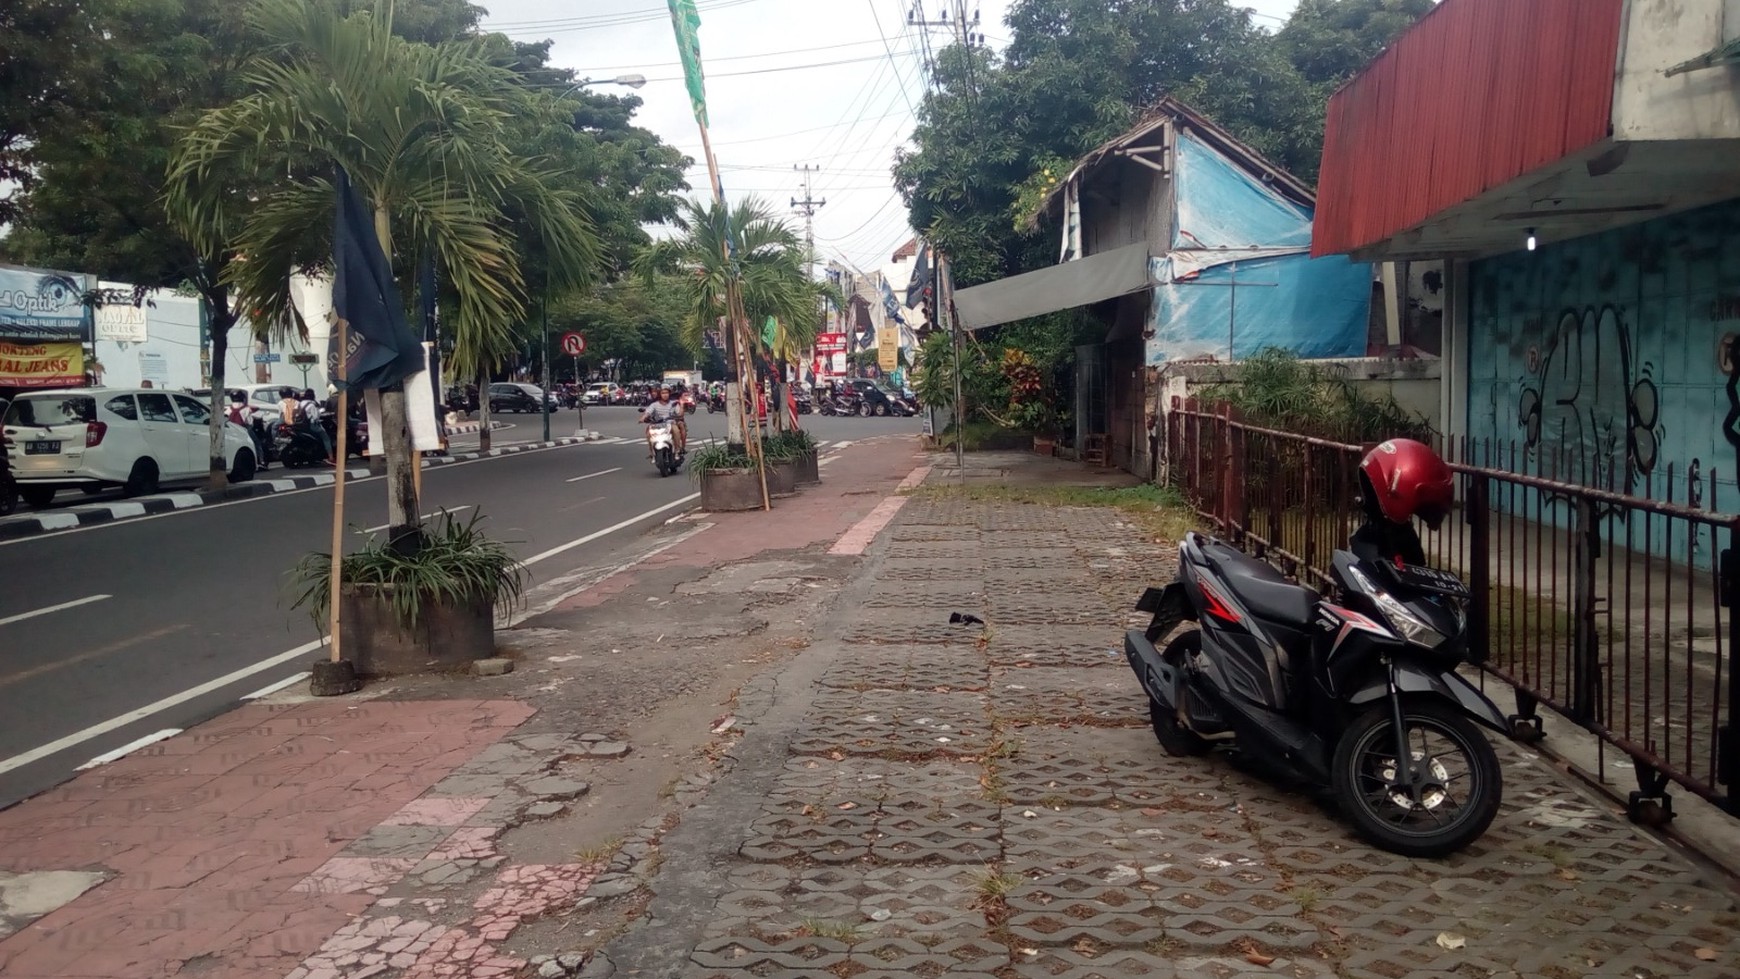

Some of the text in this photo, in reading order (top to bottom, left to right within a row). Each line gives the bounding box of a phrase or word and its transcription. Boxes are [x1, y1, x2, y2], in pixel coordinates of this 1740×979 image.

[13, 290, 58, 316] Optik
[0, 344, 47, 356] OKTENG
[25, 359, 69, 373] JEANS
[1318, 607, 1340, 626] HONDA
